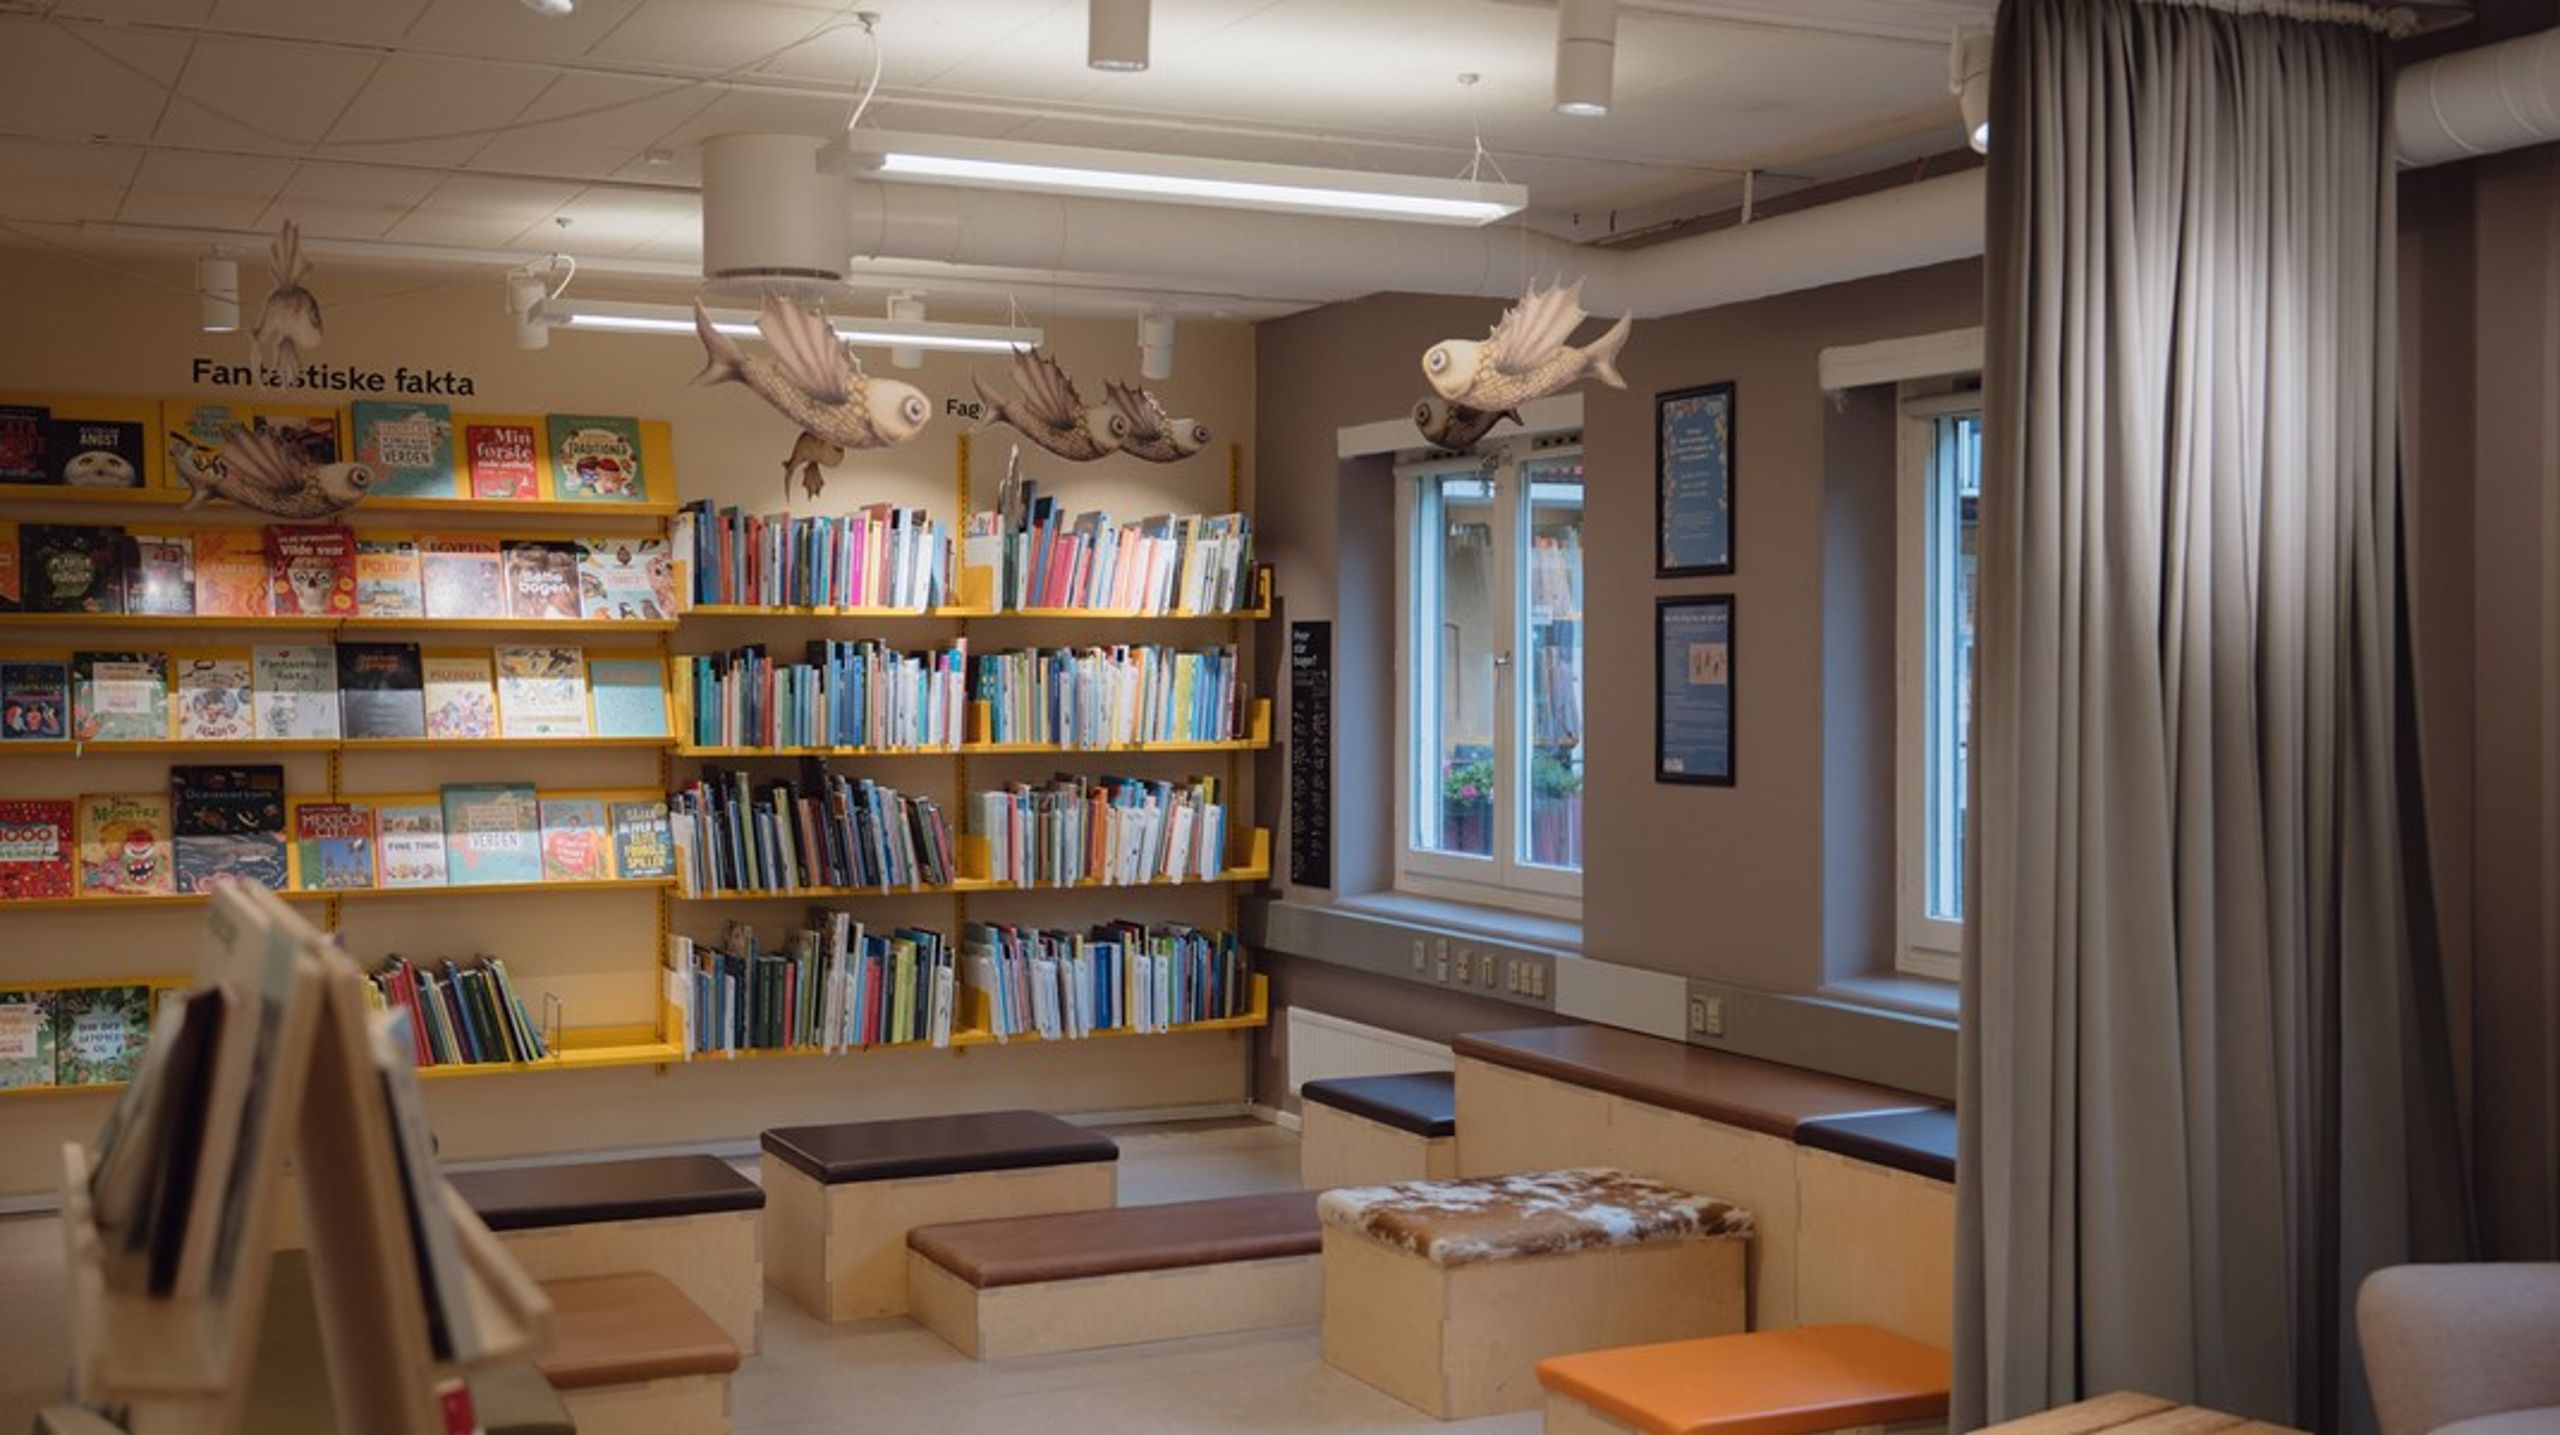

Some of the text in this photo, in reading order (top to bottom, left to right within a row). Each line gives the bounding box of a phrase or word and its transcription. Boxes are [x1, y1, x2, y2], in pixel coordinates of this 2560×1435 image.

[395, 367, 475, 396] fakta
[494, 427, 531, 444] Min
[302, 813, 363, 829] MEXICO
[315, 826, 351, 839] CITY
